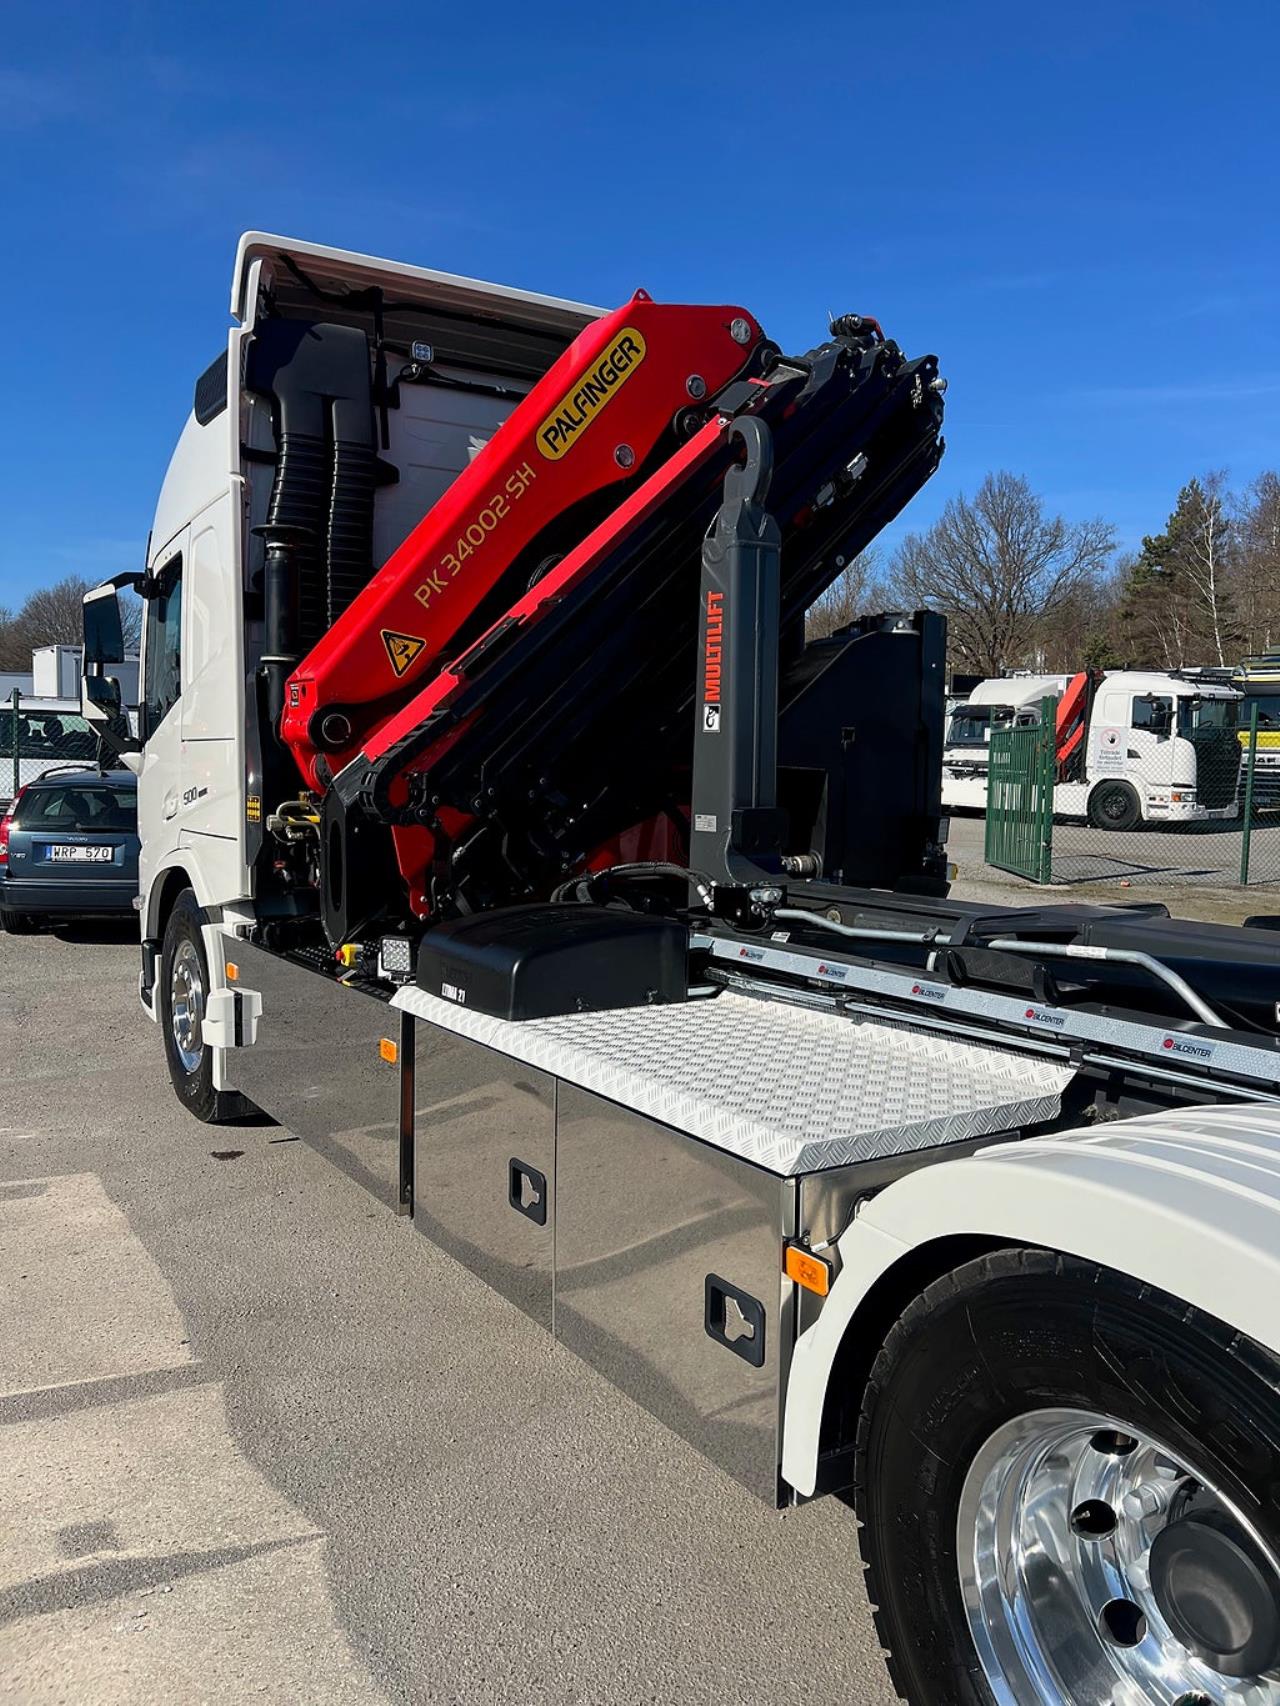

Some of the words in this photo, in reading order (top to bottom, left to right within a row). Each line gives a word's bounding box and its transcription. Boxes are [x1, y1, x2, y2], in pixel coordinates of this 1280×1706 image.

[542, 335, 641, 454] PALFINGER
[414, 568, 449, 609] PK
[705, 591, 723, 702] MULTILIFT
[183, 786, 197, 806] 500
[54, 846, 77, 857] WRP
[85, 846, 110, 858] 570
[918, 988, 945, 1000] BILCENTER
[1033, 1013, 1065, 1026] BILCENTER
[1172, 1042, 1212, 1058] BILCENTER
